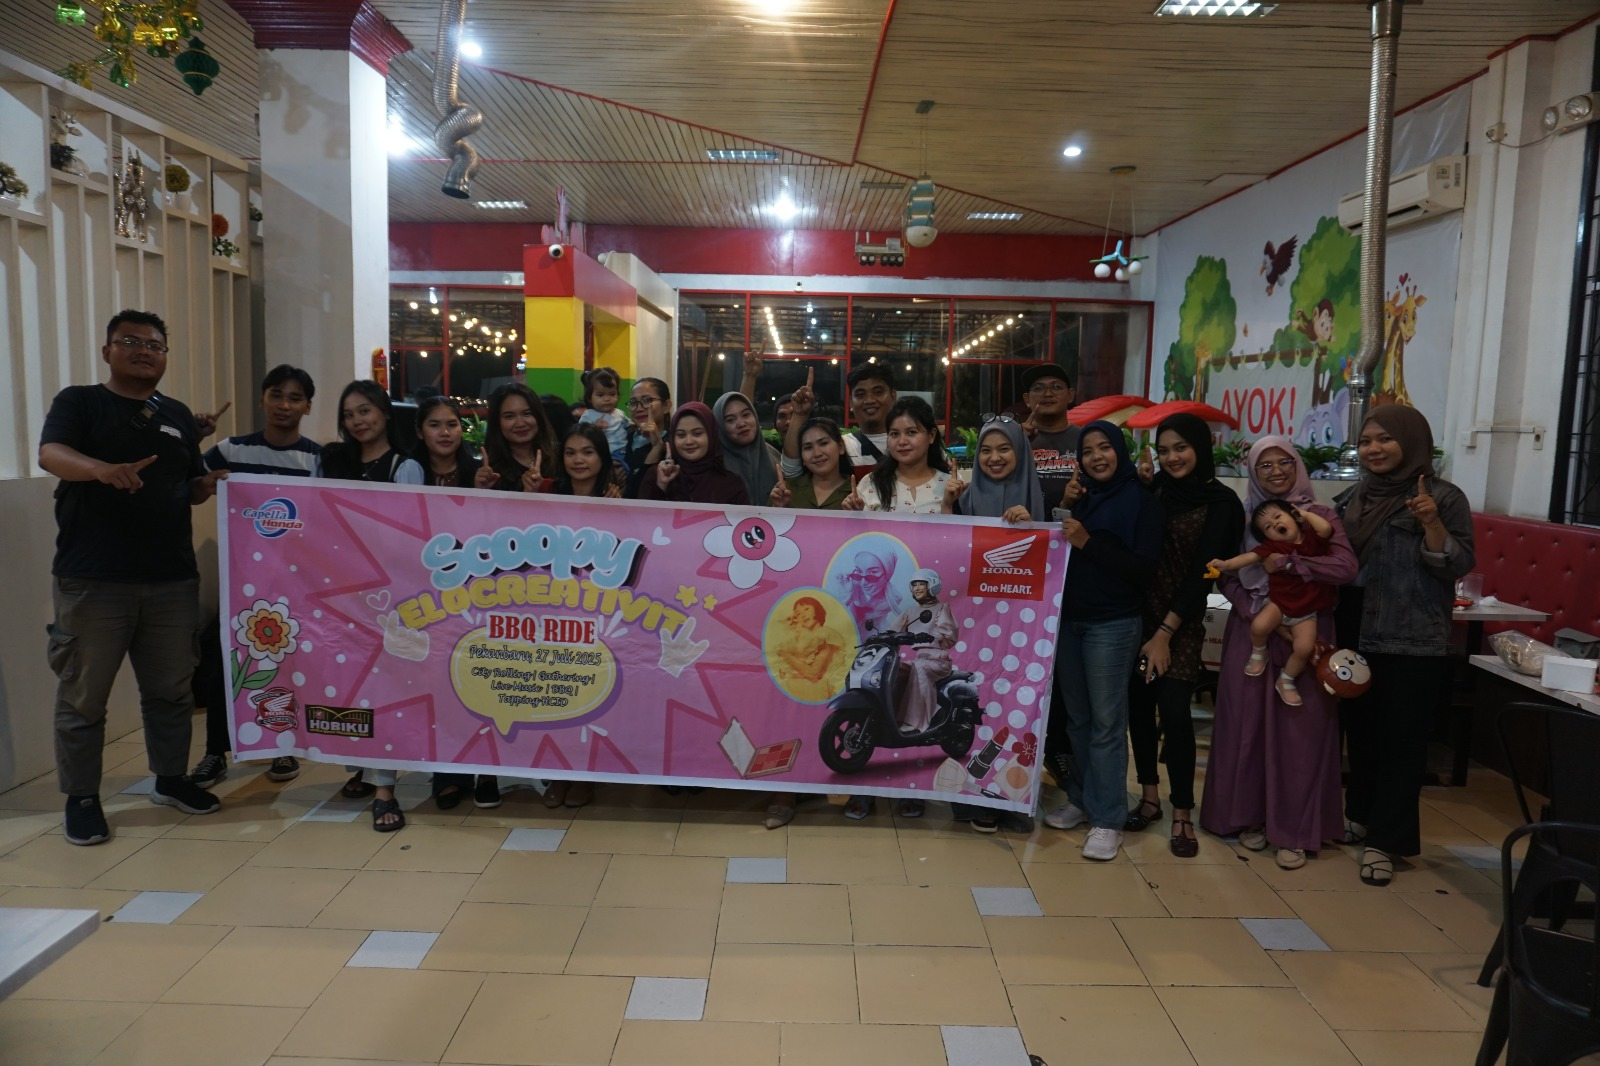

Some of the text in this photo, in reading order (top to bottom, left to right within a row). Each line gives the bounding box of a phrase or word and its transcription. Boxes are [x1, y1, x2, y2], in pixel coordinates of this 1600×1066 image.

[1221, 386, 1296, 435] AYOK!
[1036, 459, 1077, 471] BAREN
[242, 507, 288, 520] Capella
[262, 519, 303, 529] Honda
[982, 567, 1034, 576] HONDA
[979, 582, 1032, 595] One HEART.
[488, 614, 596, 645] BBQ RIDE
[535, 648, 550, 663] 27
[549, 648, 575, 666] Juli
[575, 651, 602, 666] 2025
[471, 666, 493, 679] City
[493, 668, 533, 682] Rolling
[538, 670, 591, 686] Gathering
[490, 679, 512, 691] Live
[512, 681, 543, 693] Music
[551, 684, 574, 697] BBQ
[498, 693, 541, 708] Tapping
[309, 719, 370, 734] HOBIKU
